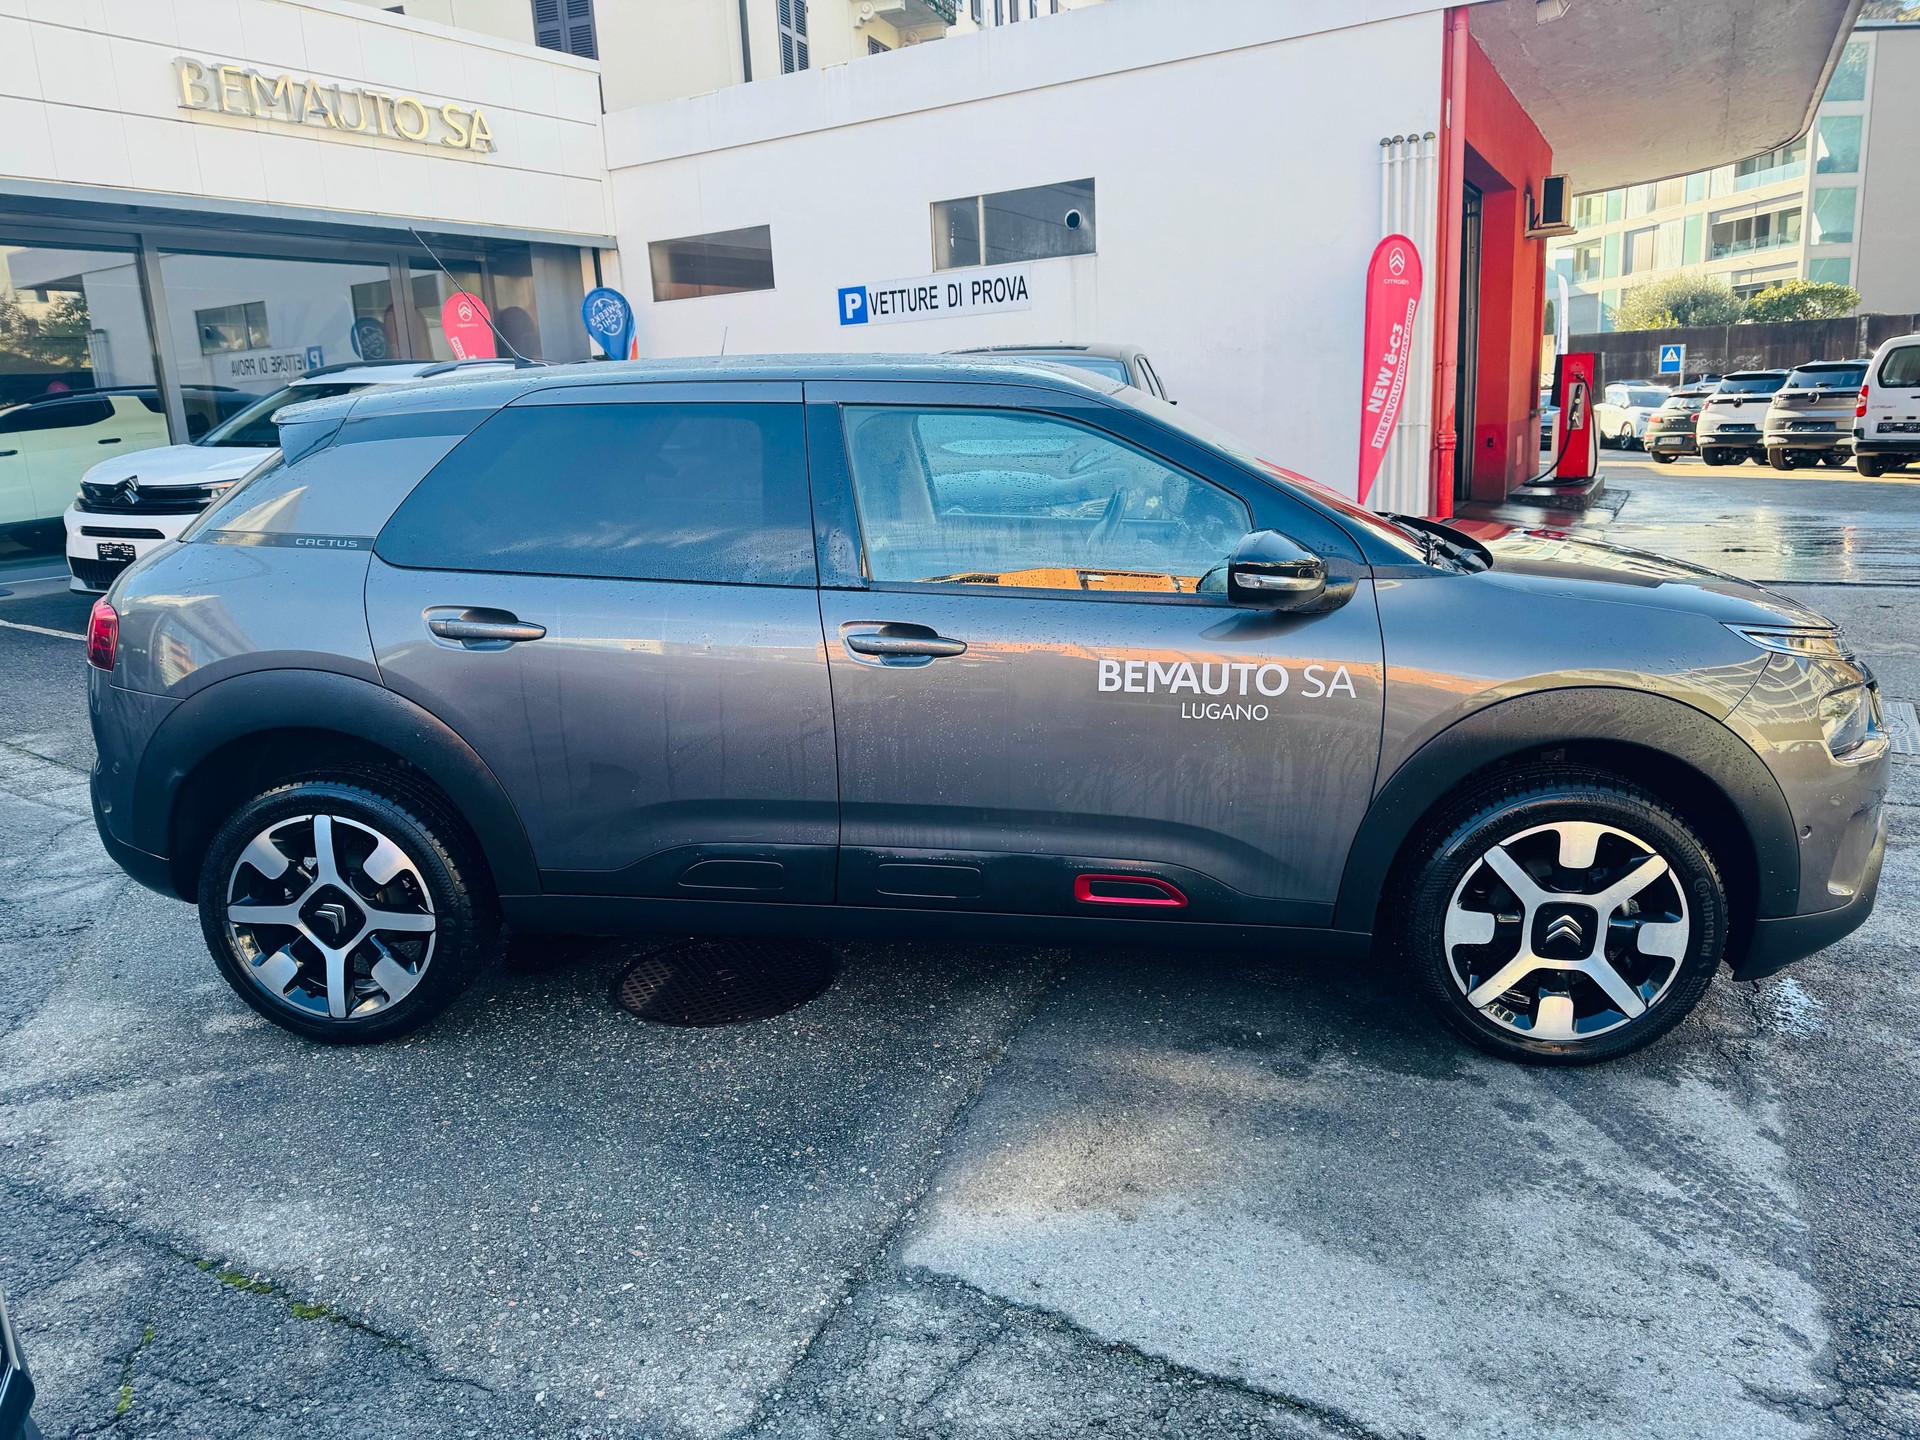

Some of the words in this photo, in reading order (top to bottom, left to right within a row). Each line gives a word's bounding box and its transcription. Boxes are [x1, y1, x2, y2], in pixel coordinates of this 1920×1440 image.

[173, 56, 430, 142] BEMAUTO
[438, 103, 497, 153] SA
[845, 292, 862, 319] P
[869, 285, 939, 316] VETTURE
[947, 282, 963, 308] DI
[971, 275, 1029, 305] PROVA
[1366, 366, 1393, 414] NEW
[1373, 424, 1388, 446] THE
[1383, 360, 1405, 424] REVOLUTION
[295, 538, 358, 548] CACTUS
[1098, 659, 1290, 697] BEMAUTO
[1301, 664, 1357, 699] SA
[1181, 702, 1269, 721] LUGANO
